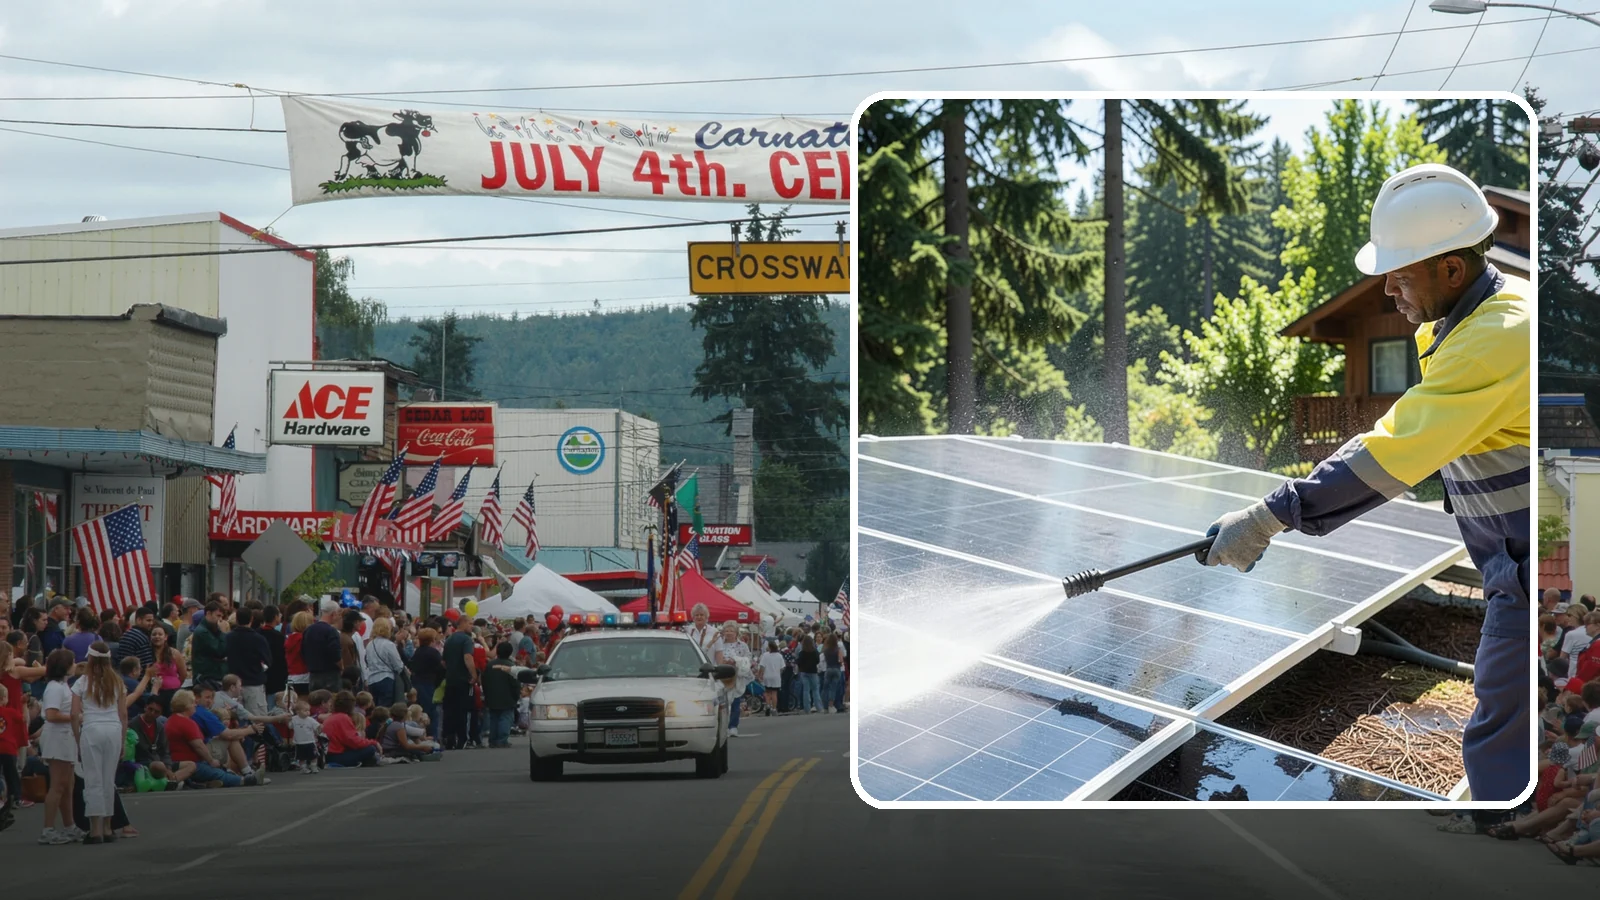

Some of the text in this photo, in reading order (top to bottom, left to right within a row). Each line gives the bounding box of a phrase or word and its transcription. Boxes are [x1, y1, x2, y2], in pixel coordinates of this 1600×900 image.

[695, 121, 850, 149] Carnat
[481, 141, 605, 192] JULY
[632, 150, 746, 198] 4th.
[697, 254, 850, 280] CROSSWA
[282, 380, 373, 420] ACE
[405, 410, 453, 422] CEDAR
[283, 421, 371, 437] Hardware
[416, 428, 477, 447] Coca-Cola
[353, 467, 386, 480] Simpl
[95, 484, 124, 495] Vincent
[126, 486, 136, 495] de
[137, 486, 155, 495] Paul
[688, 526, 742, 535] CRNATION
[699, 535, 730, 543] GLASS
